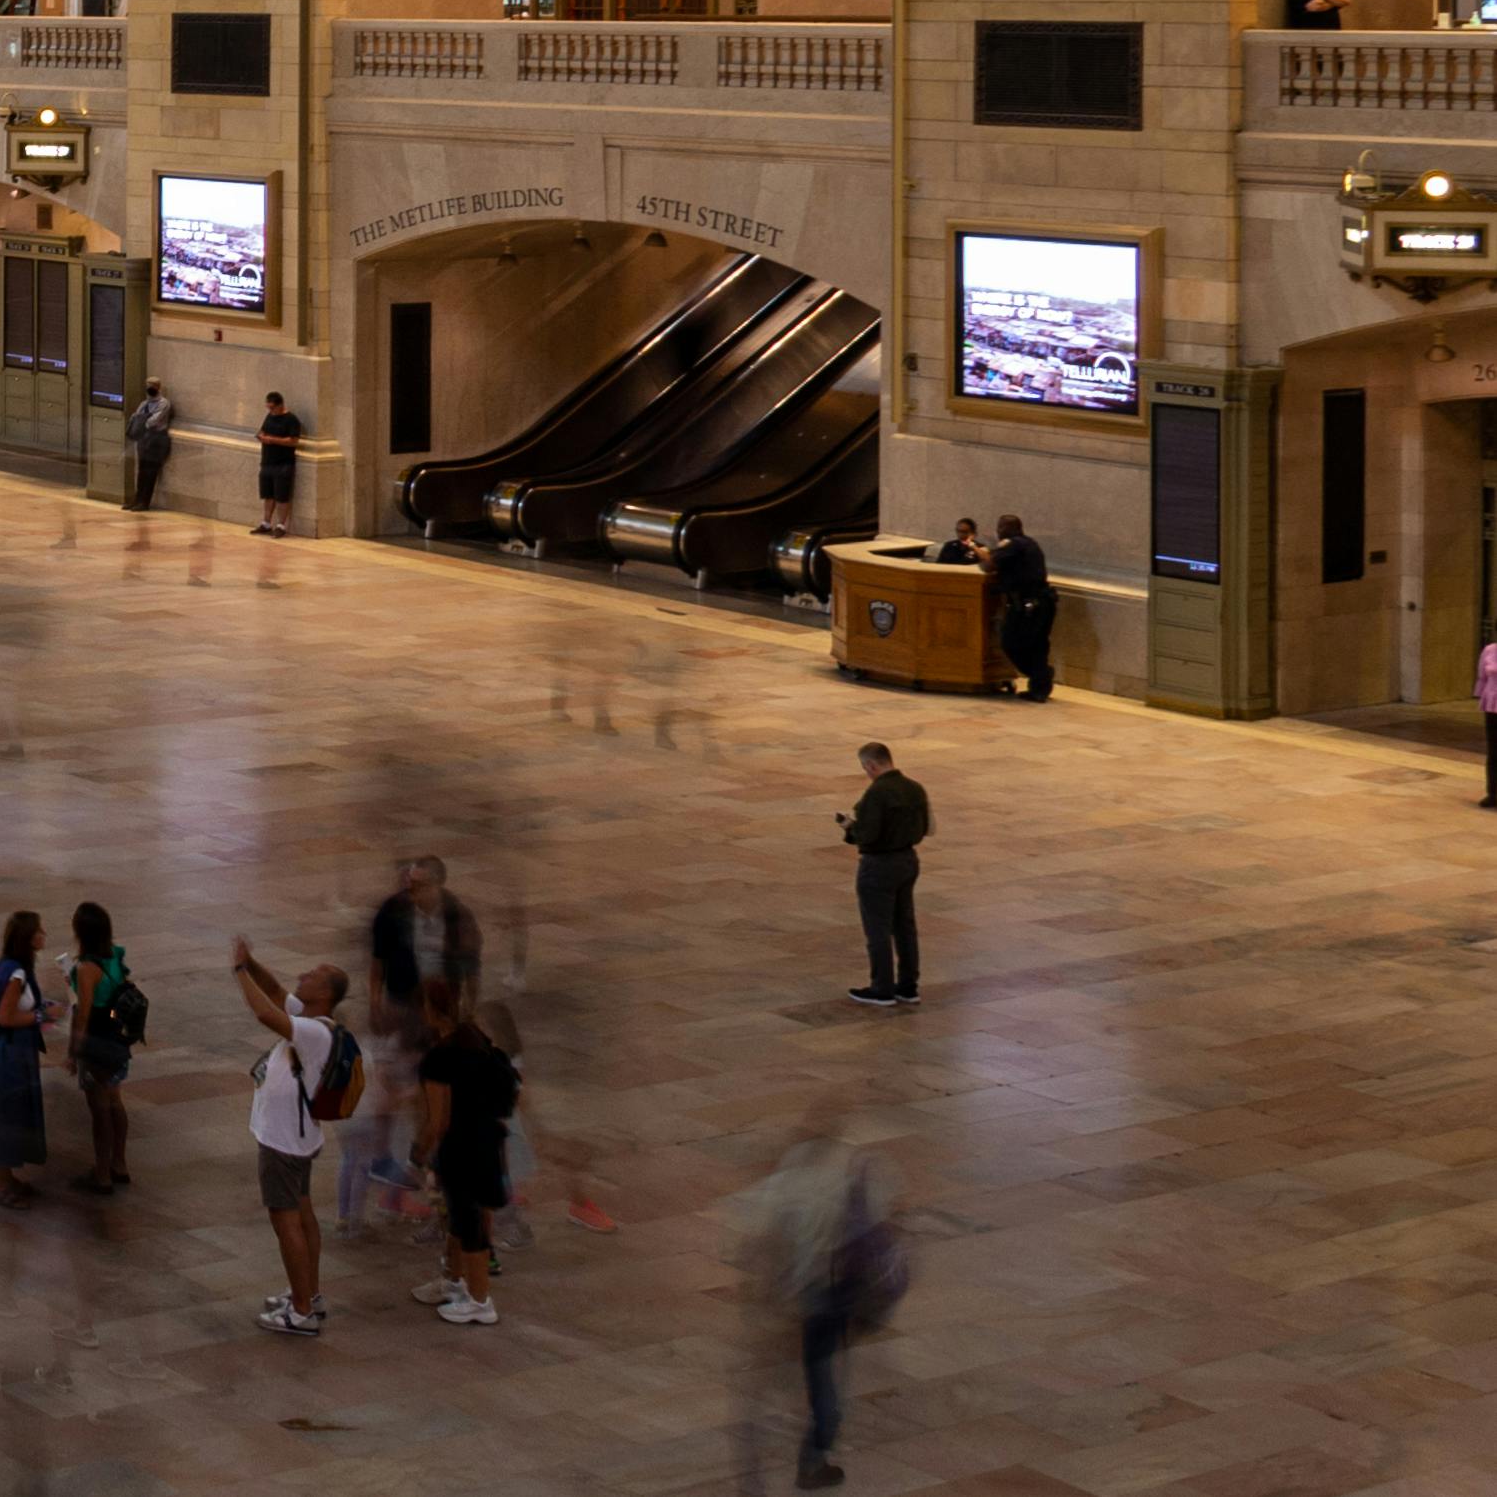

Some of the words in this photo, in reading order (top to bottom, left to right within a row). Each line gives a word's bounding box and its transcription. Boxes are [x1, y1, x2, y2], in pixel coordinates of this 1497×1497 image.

[350, 219, 387, 247] THE
[389, 195, 467, 233] METLIFE
[470, 187, 564, 214] BUILDING
[636, 195, 691, 223] 45TH
[696, 206, 784, 248] STREET
